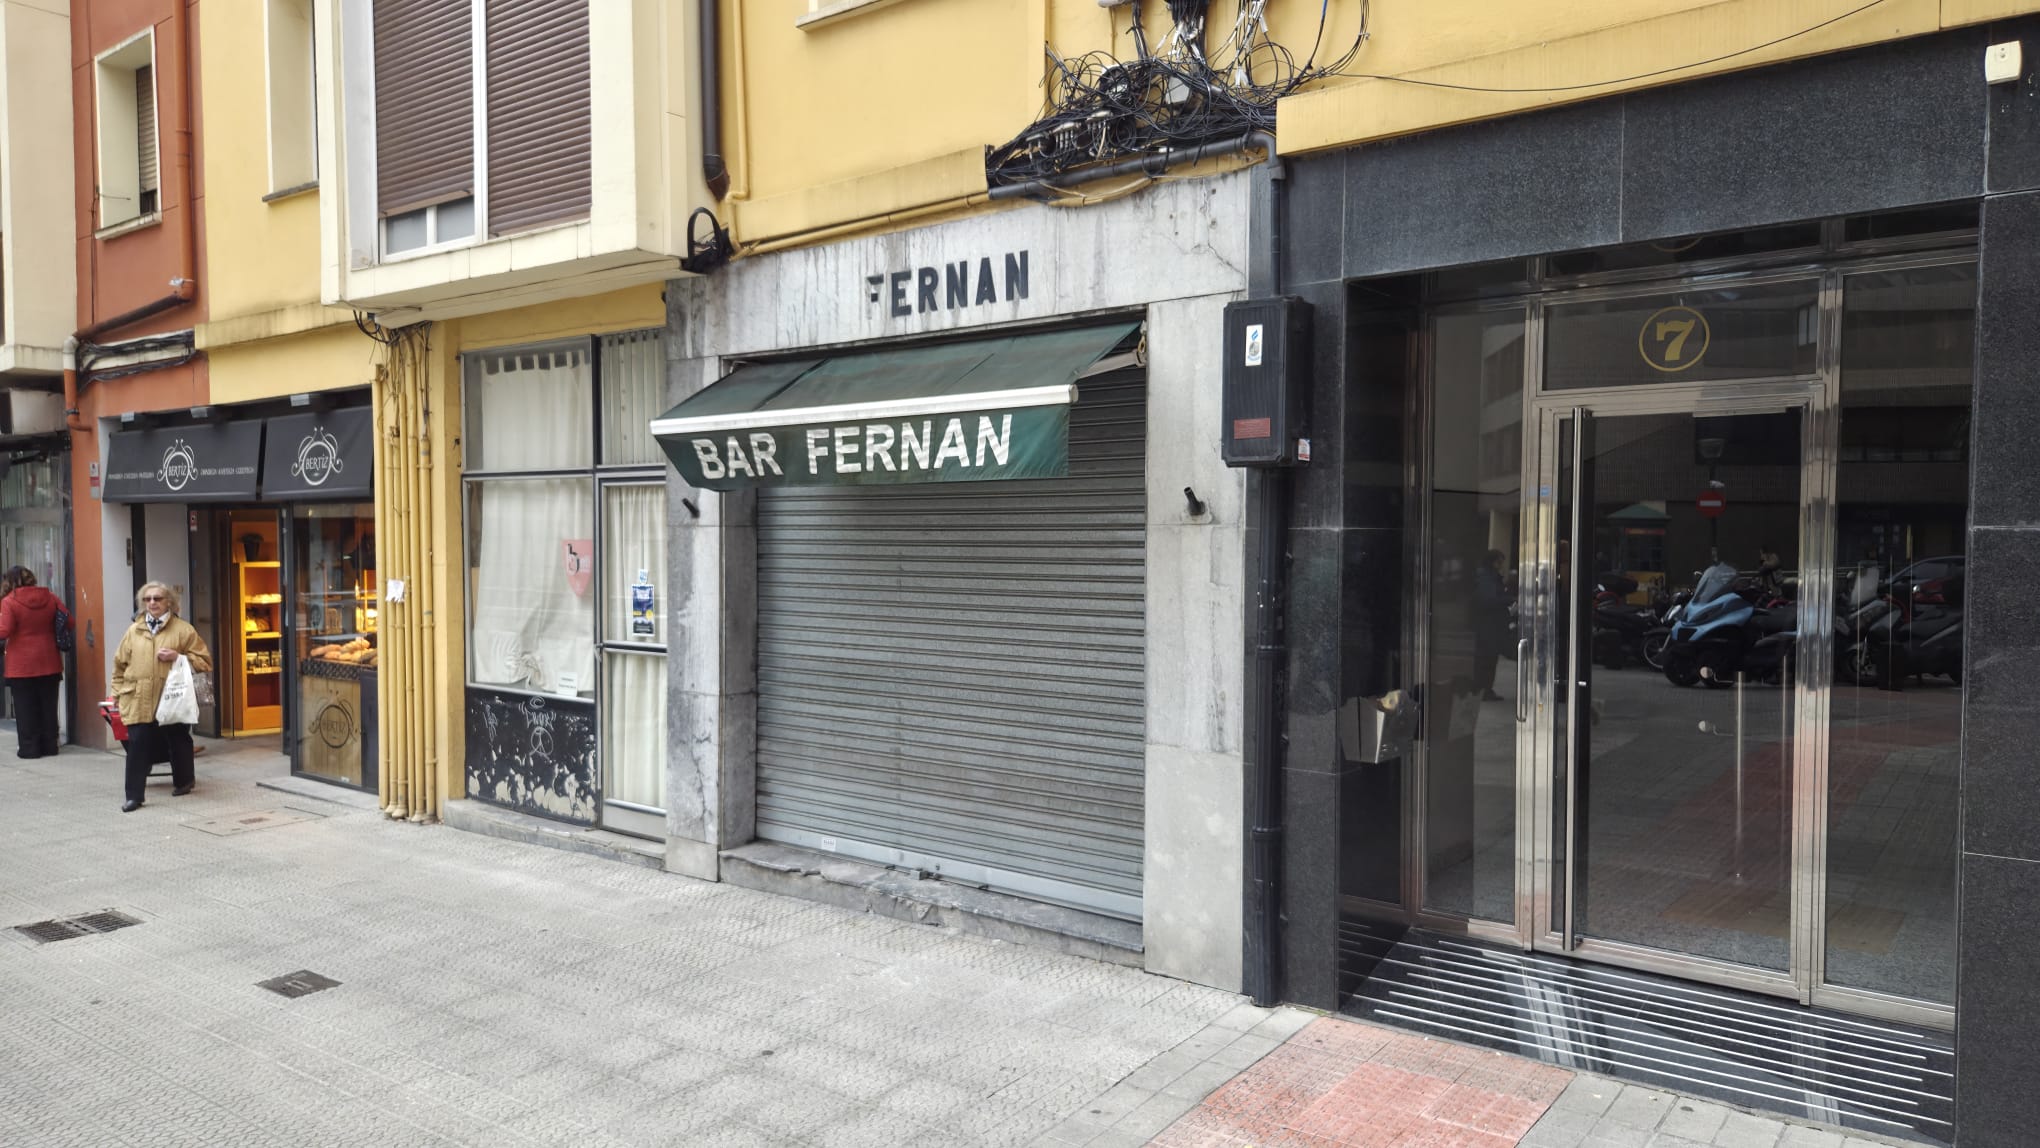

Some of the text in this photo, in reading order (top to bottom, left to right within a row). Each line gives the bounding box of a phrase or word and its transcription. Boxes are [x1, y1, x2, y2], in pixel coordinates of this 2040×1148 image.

[867, 250, 1029, 317] FERNAN
[1656, 319, 1695, 361] 7
[691, 414, 1013, 480] BAR FERNAN
